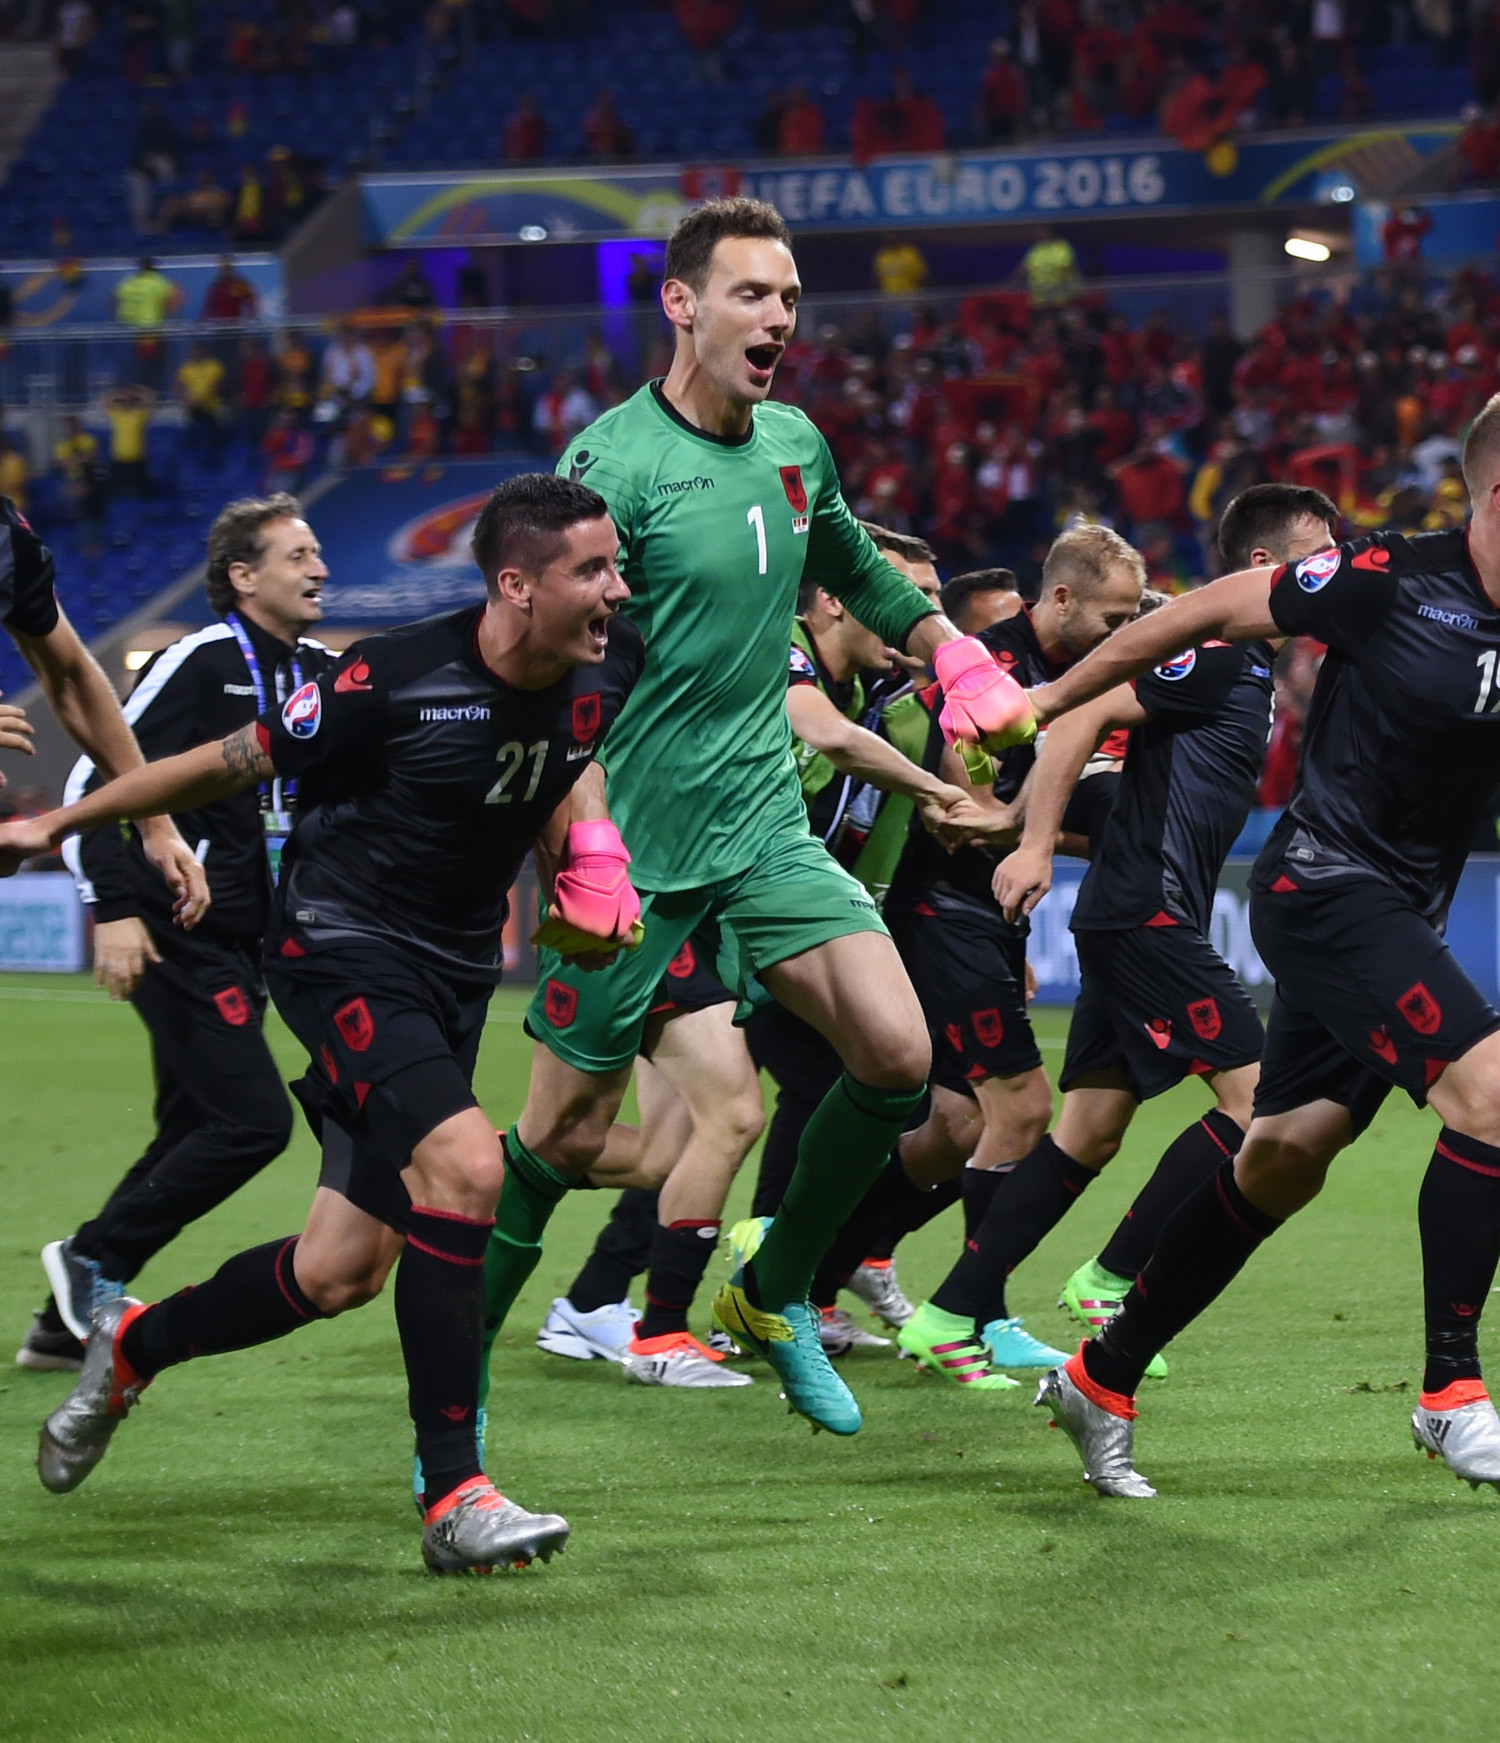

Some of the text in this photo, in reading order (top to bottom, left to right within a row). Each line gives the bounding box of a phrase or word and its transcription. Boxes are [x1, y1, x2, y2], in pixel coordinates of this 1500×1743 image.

[882, 163, 1026, 217] EURO
[1033, 155, 1167, 209] 2016
[657, 476, 715, 496] macron
[746, 505, 768, 575] 1
[1417, 604, 1479, 630] macron
[420, 705, 491, 721] macron
[483, 740, 550, 805] 21
